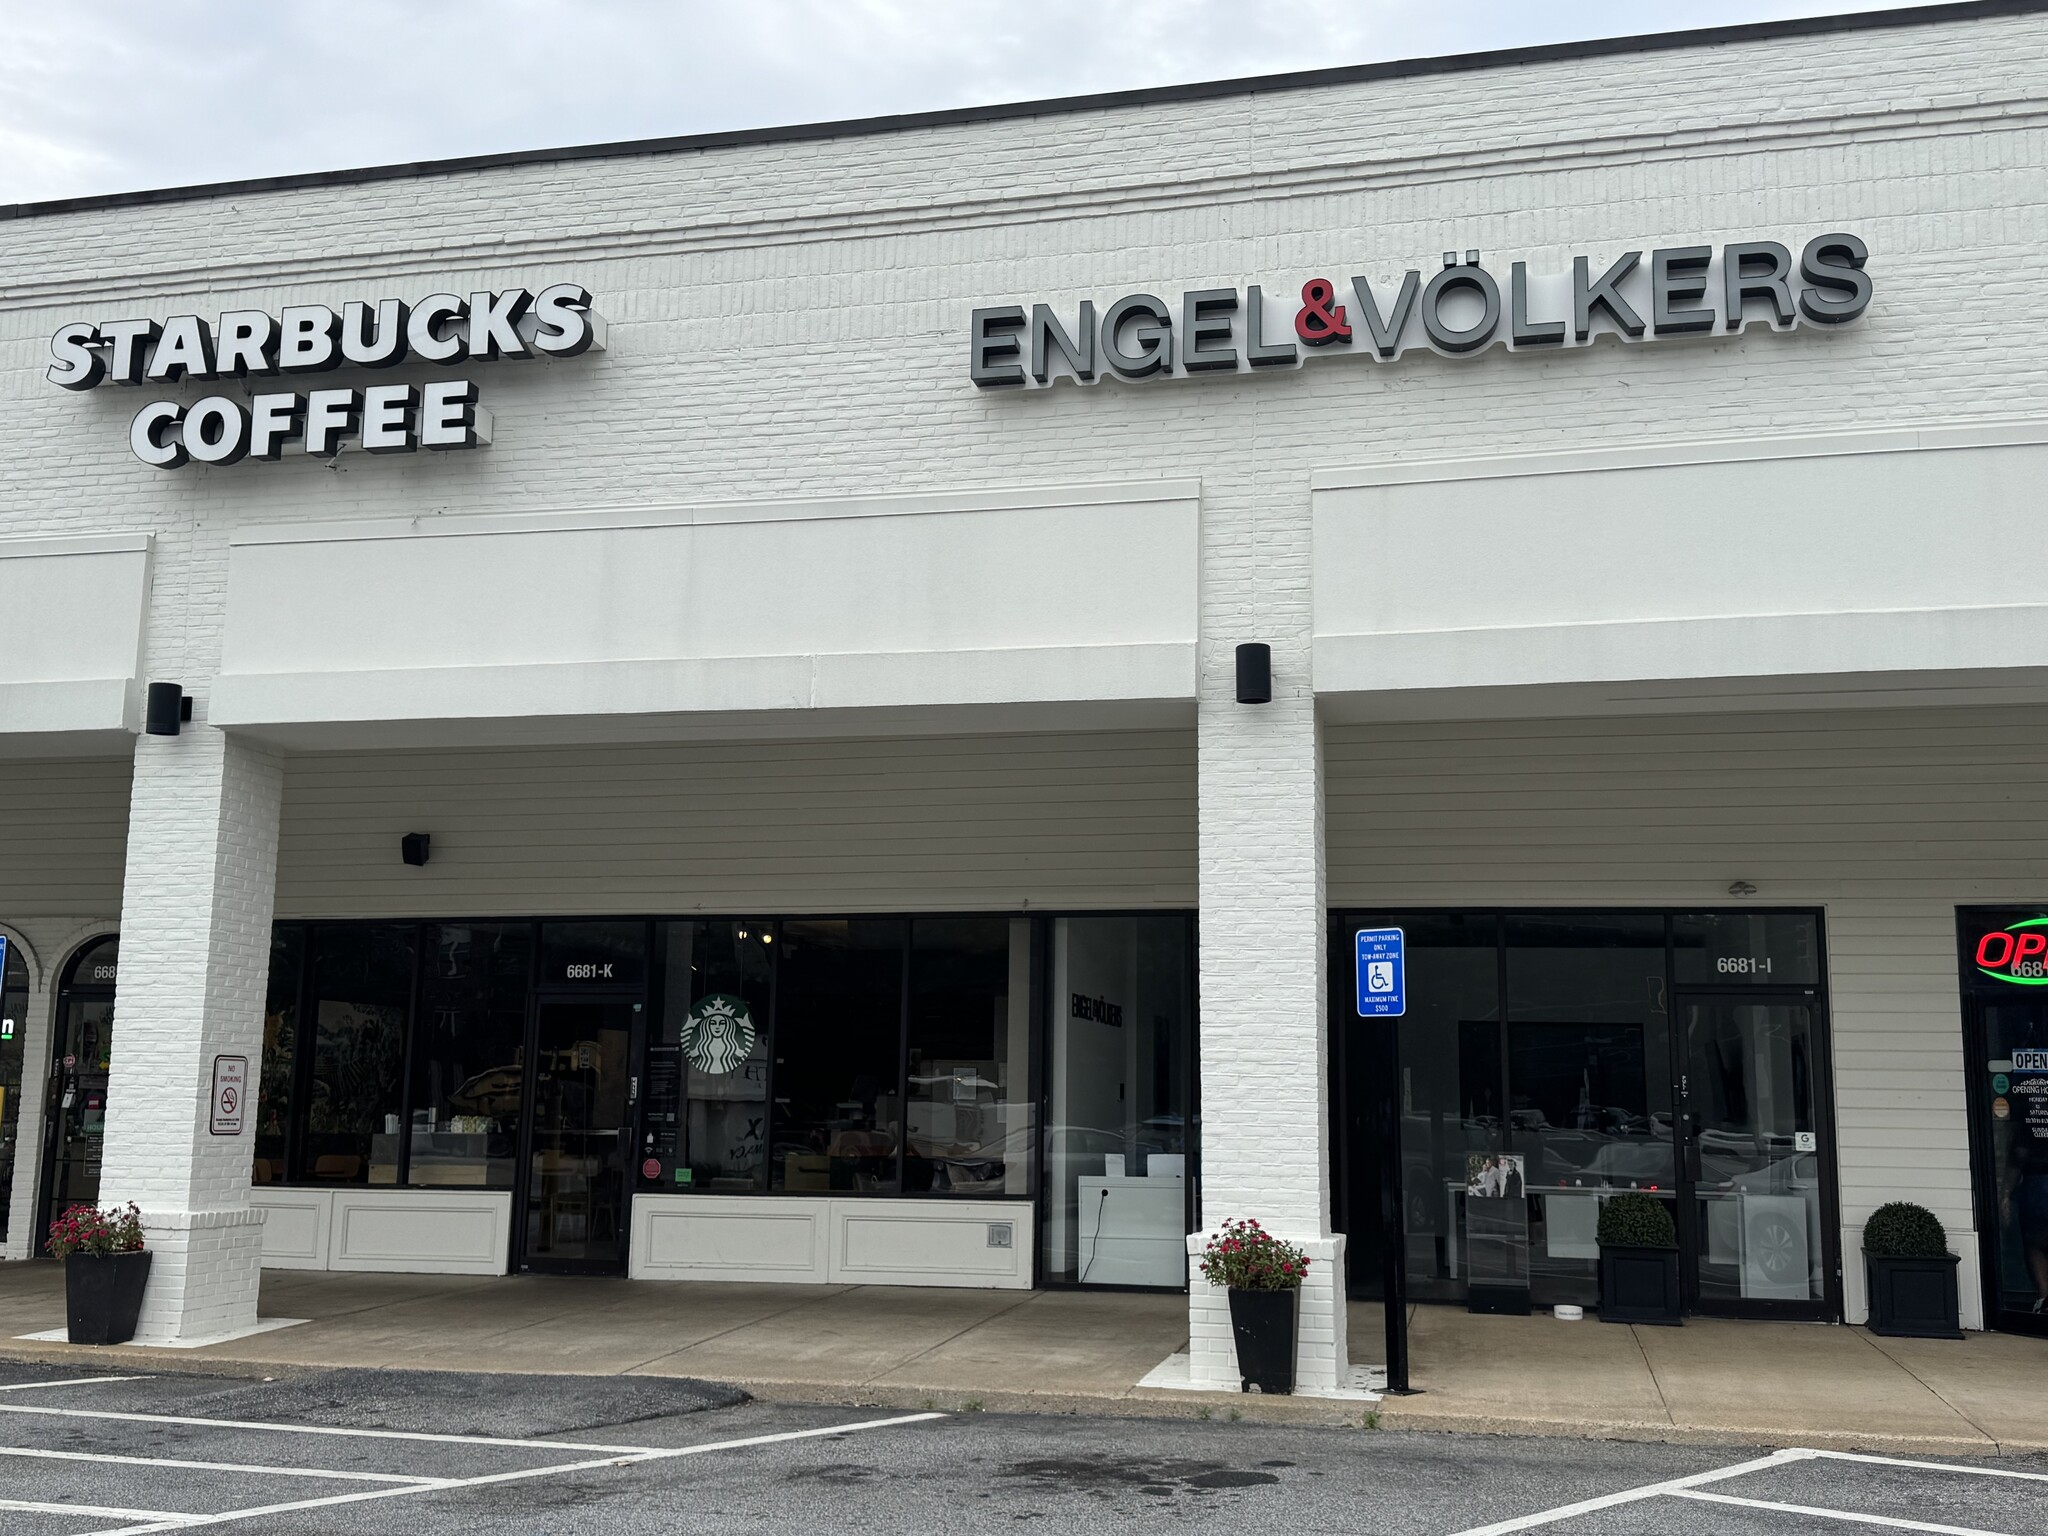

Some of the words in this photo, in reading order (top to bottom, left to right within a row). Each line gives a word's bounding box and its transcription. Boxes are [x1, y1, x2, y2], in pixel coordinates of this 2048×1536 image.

[47, 283, 594, 391] STARBUCKS
[129, 379, 480, 469] COFFEE
[1360, 935, 1378, 943] PERMIT
[1378, 934, 1400, 942] PARKING
[1361, 953, 1386, 961] TOW-AWAY
[1386, 952, 1400, 960] ZONE
[1976, 931, 2048, 970] OP
[94, 965, 116, 979] 668
[566, 963, 613, 978] 6681-K
[2010, 961, 2048, 977] 668
[1364, 996, 1387, 1004] MAXIMUM
[1387, 995, 1399, 1003] FINE
[1375, 1004, 1389, 1013] $500
[2015, 1053, 2048, 1069] OPEN
[227, 1065, 236, 1073] NO
[220, 1075, 242, 1084] SMOKING
